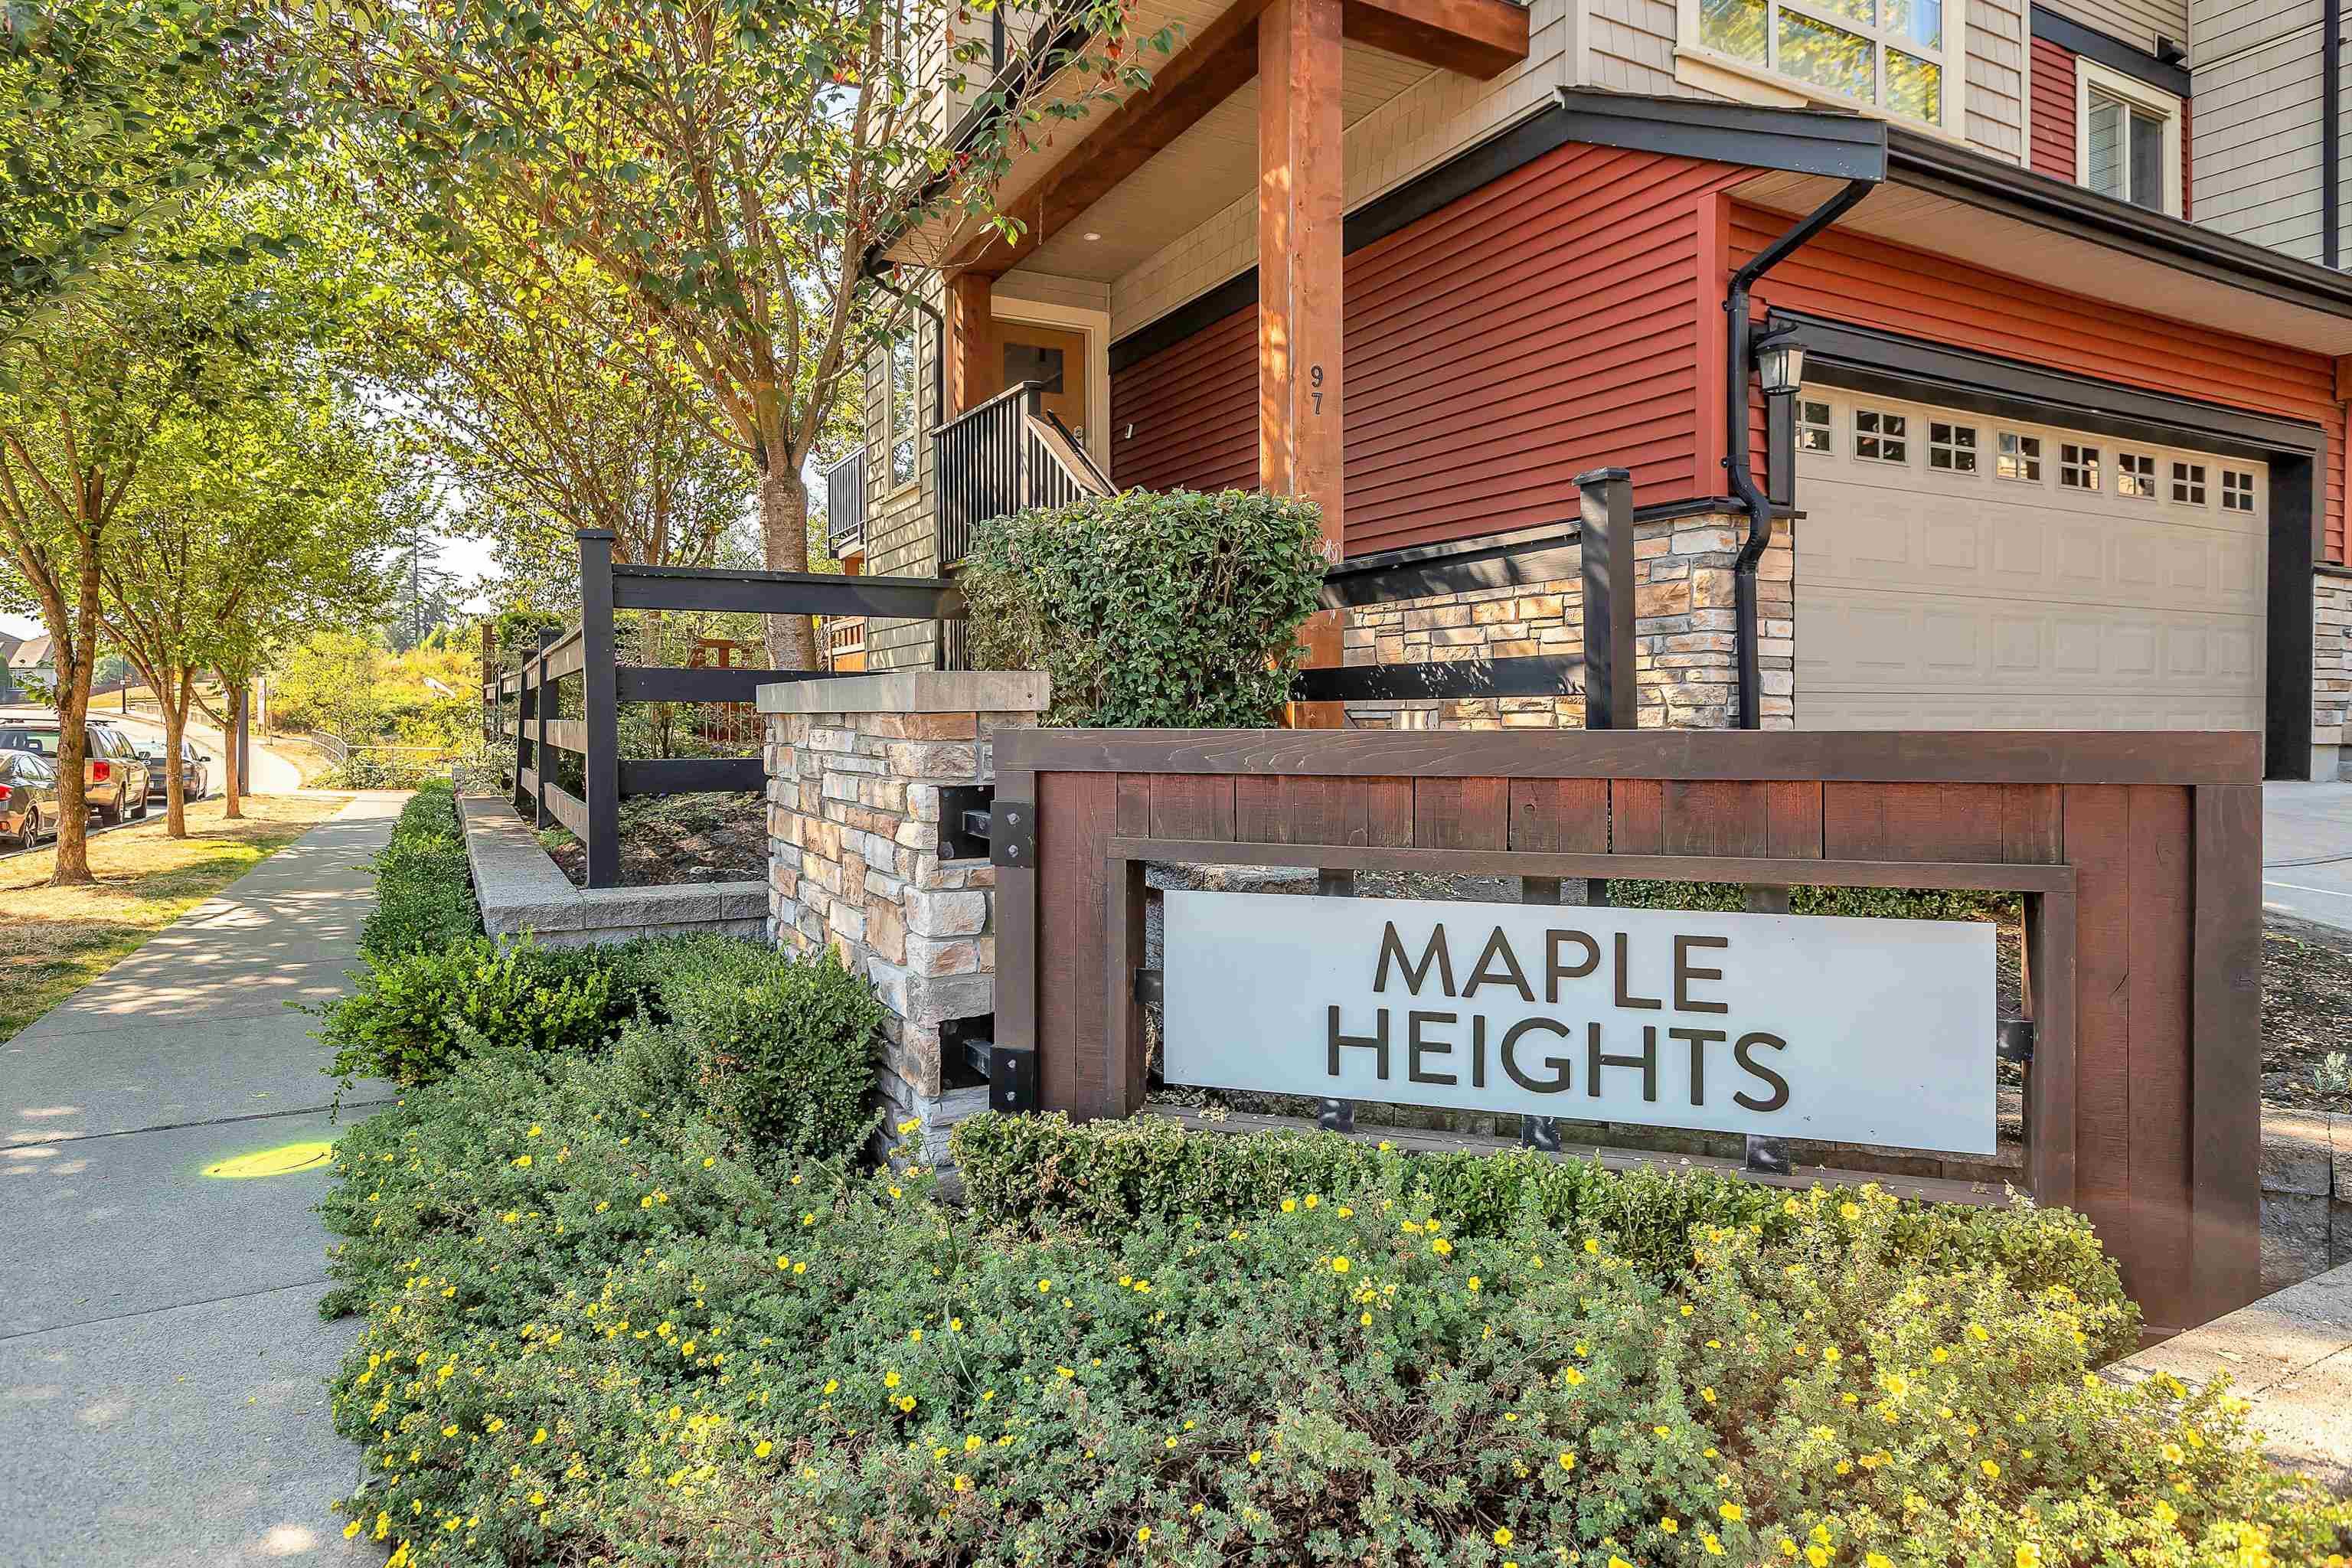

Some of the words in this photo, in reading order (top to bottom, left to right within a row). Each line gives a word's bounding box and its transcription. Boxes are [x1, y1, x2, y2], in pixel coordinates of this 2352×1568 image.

[1310, 364, 1323, 415] 97
[1374, 921, 1728, 1014] MAPLE
[1328, 1005, 1789, 1112] HEIGHTS
